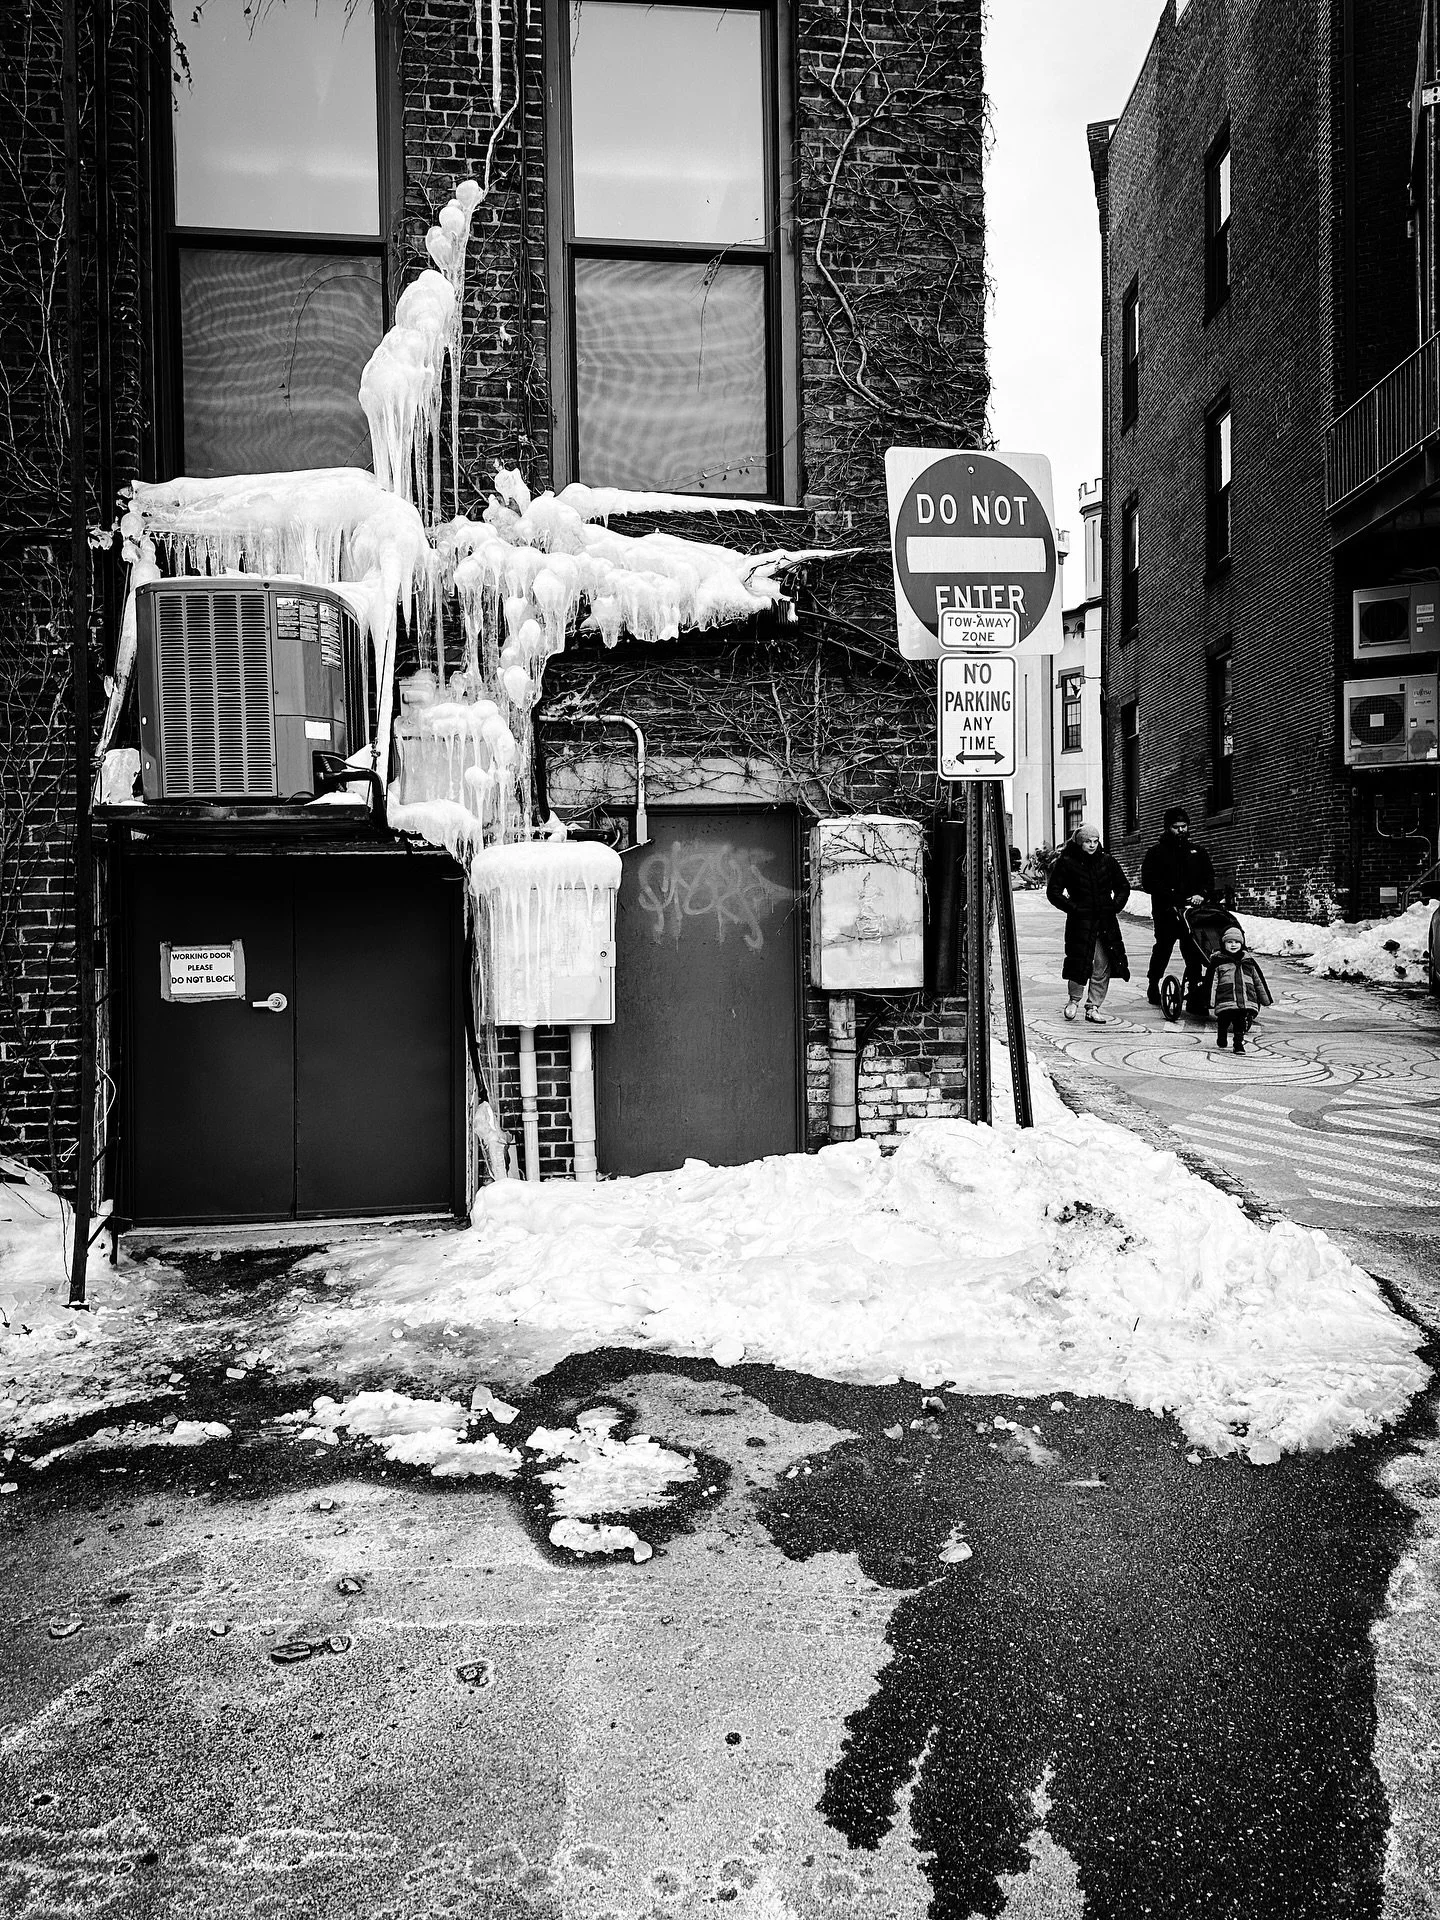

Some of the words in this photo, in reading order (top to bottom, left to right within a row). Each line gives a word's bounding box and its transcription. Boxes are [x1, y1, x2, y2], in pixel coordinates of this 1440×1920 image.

[916, 493, 957, 524] DO
[972, 495, 1028, 525] NOT
[935, 585, 1025, 614] ENTER
[947, 617, 1011, 628] TOW-AWAY
[962, 631, 995, 642] ZONE
[964, 663, 992, 684] NO
[945, 690, 1011, 712] PARKING
[963, 716, 993, 731] ANY
[960, 736, 996, 750] TIME
[186, 976, 204, 984] NOT
[206, 975, 235, 983] BLOCK
